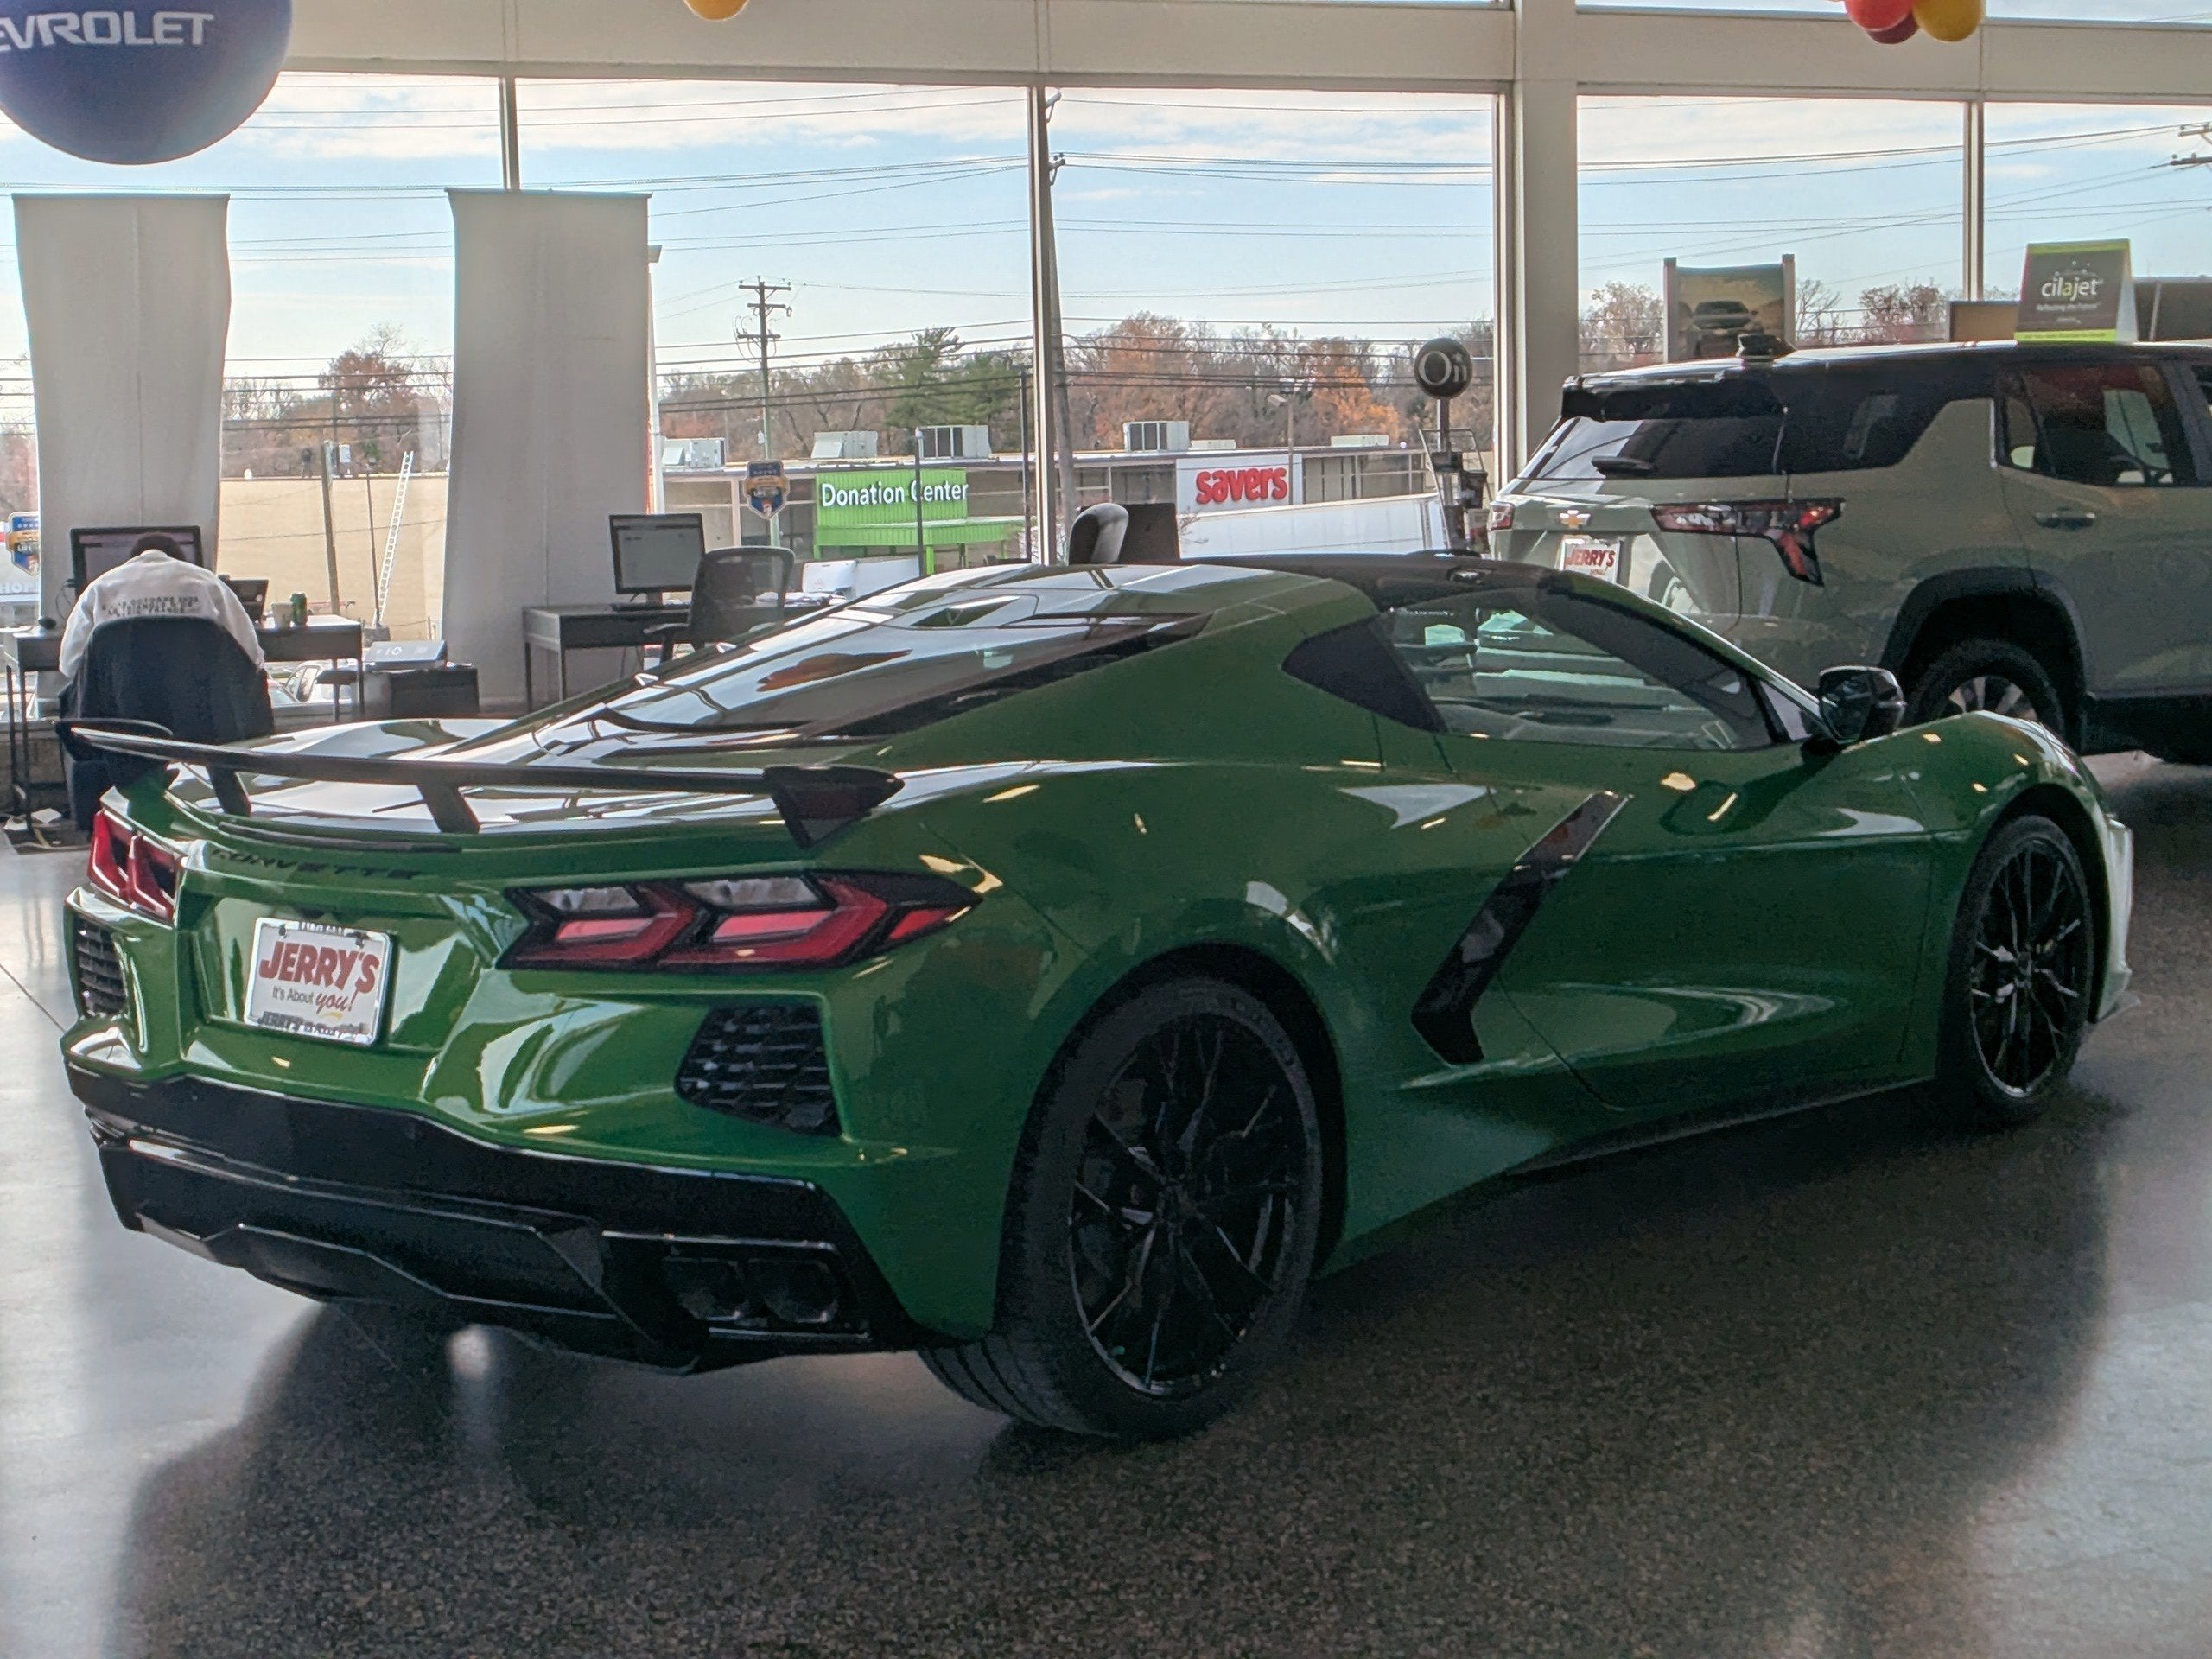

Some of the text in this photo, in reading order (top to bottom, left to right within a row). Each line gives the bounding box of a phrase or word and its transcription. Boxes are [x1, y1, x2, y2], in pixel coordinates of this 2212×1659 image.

[2041, 276, 2097, 302] cilajet
[822, 481, 905, 507] Donation
[1196, 467, 1287, 505] savers
[1566, 549, 1616, 568] JERRY'S
[259, 941, 379, 994] JERRY'S
[272, 986, 357, 1014] It's About you!
